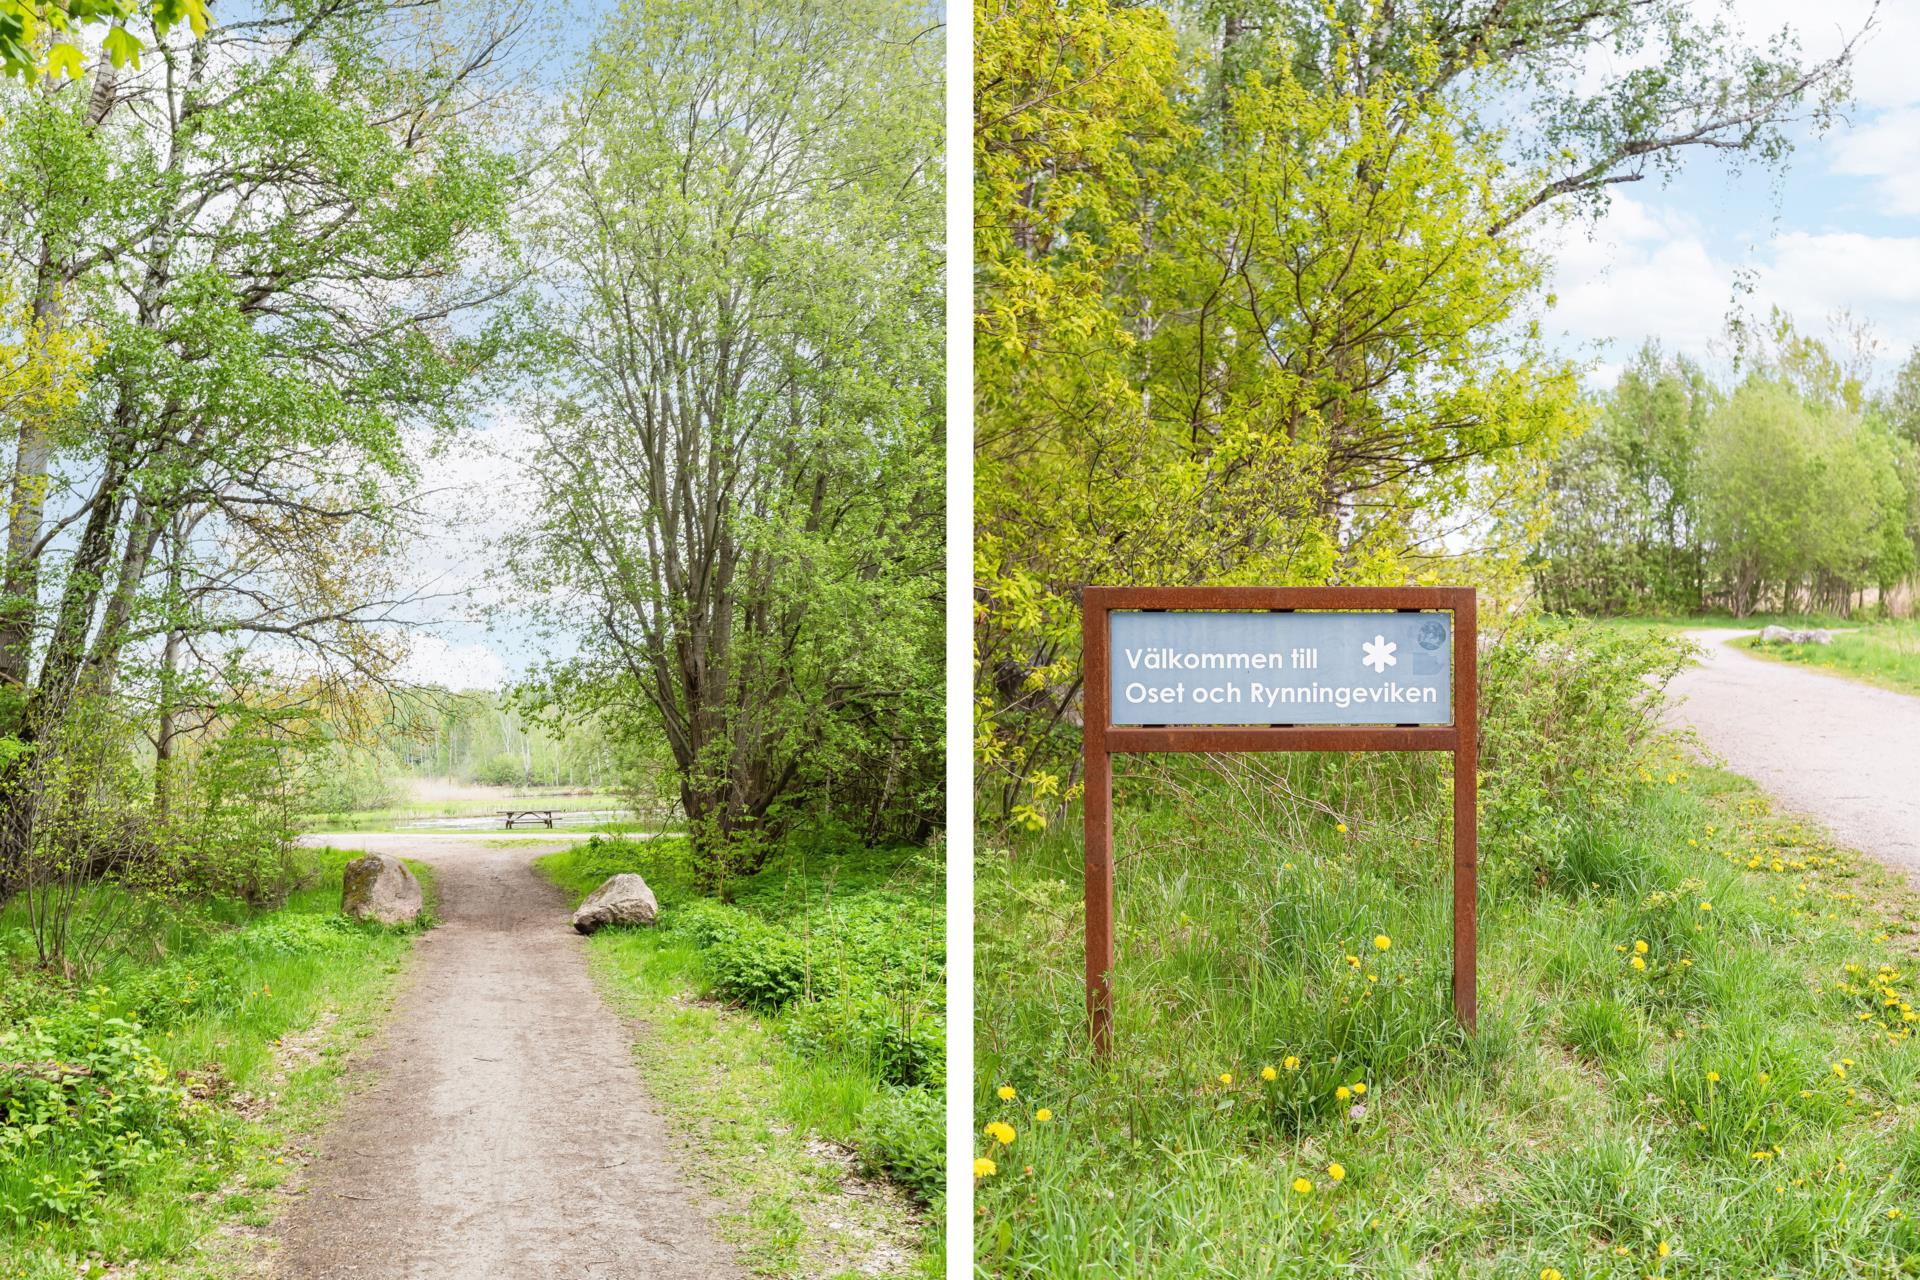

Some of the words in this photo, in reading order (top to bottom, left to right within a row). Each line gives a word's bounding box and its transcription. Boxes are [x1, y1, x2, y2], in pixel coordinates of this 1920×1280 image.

[1125, 647, 1283, 669] Välkommen
[1290, 647, 1318, 669] till
[1125, 682, 1185, 704] Oset
[1192, 682, 1241, 704] och
[1251, 682, 1437, 708] Rynningeviken
